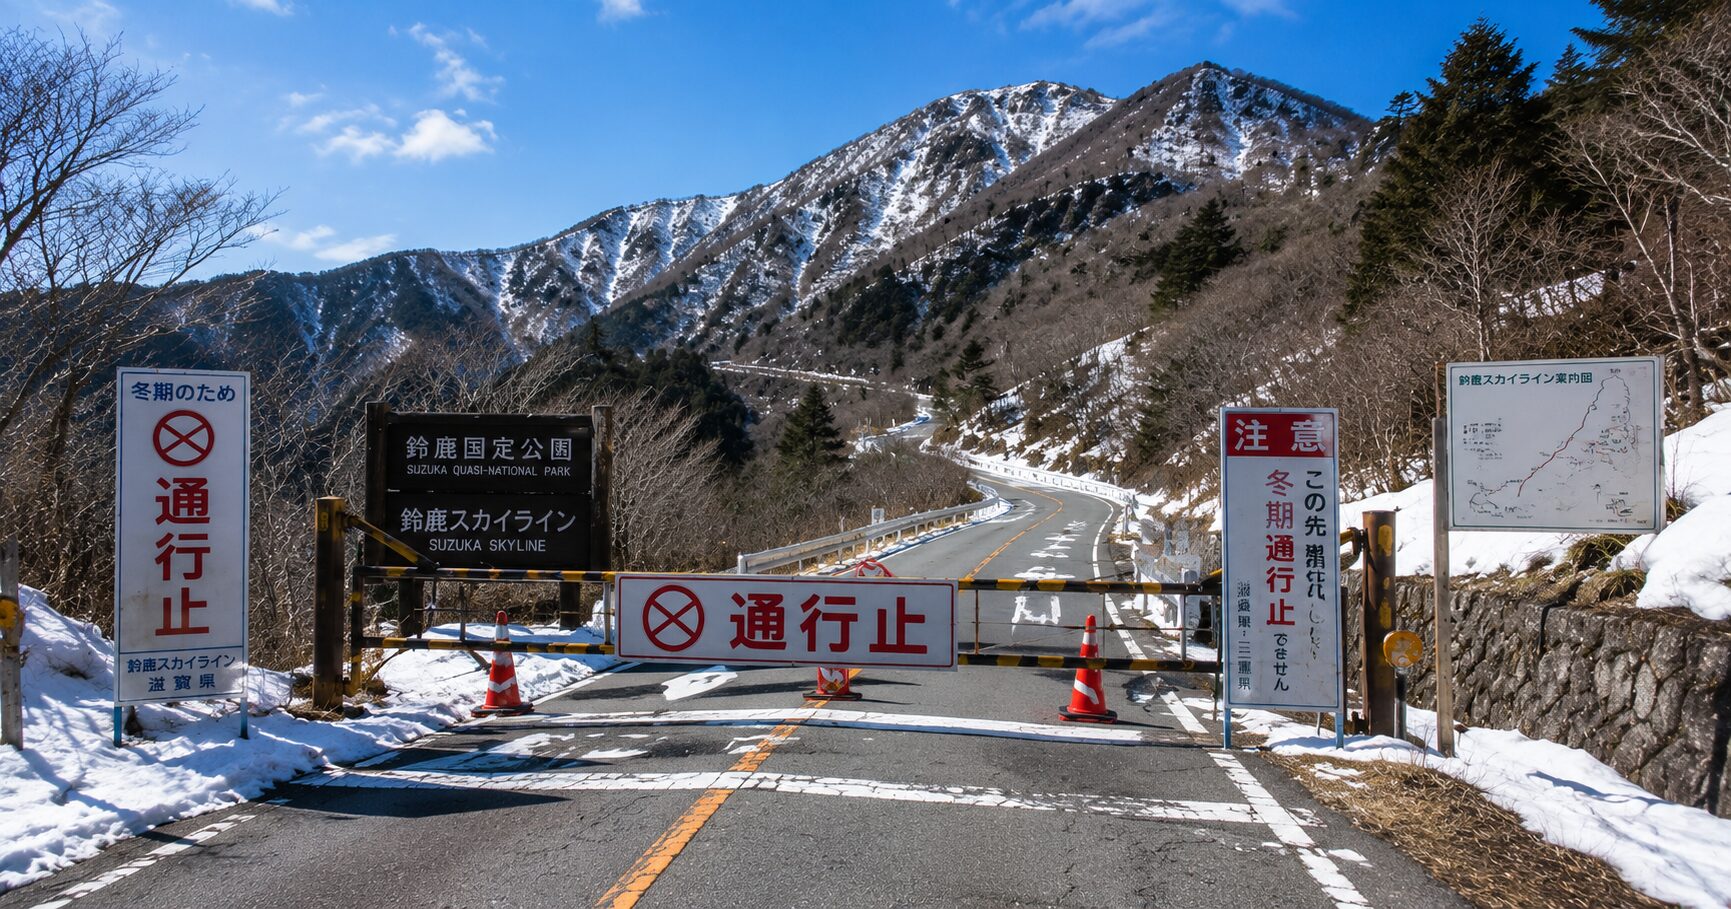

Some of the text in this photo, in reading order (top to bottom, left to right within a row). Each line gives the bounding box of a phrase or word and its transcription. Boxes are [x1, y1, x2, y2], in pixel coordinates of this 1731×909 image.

[131, 381, 236, 402] 冬期のため
[405, 435, 572, 461] 鈴鹿国定公園
[1234, 418, 1326, 452] 注意
[406, 464, 571, 477] SUZUKA QUASI-NATIONAL PARK
[400, 507, 576, 533] 鈴鹿スカイライン
[155, 476, 211, 637] 通行止
[429, 538, 546, 553] SUZUKA SKYLINE
[729, 593, 928, 654] 通行止
[127, 654, 236, 673] 鈴鹿スカイライン
